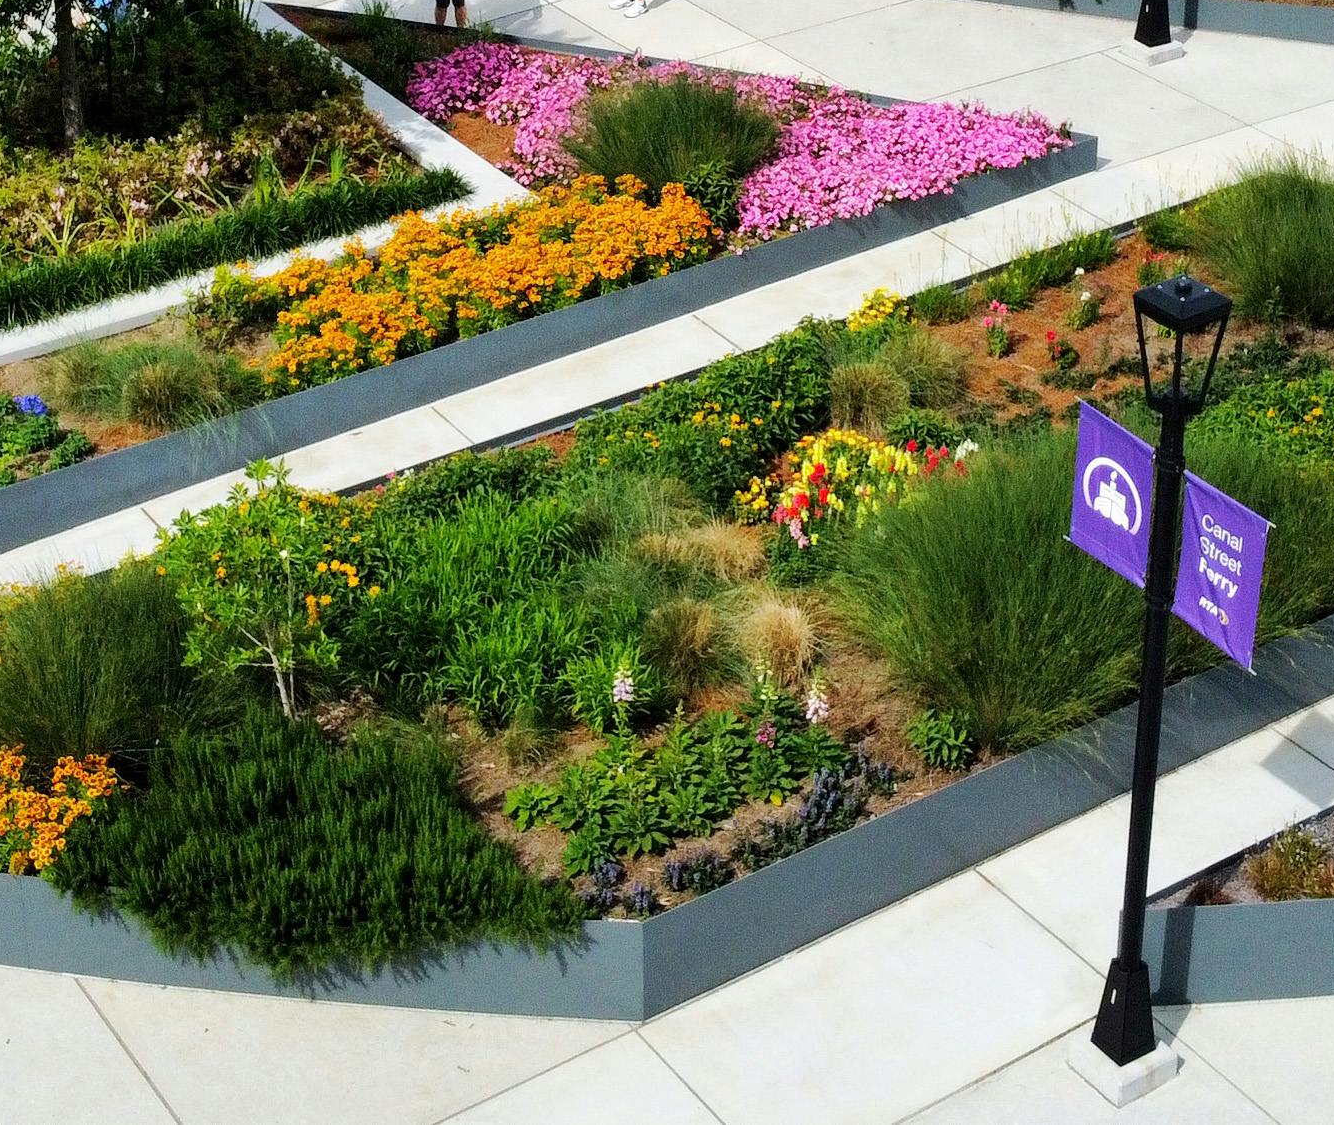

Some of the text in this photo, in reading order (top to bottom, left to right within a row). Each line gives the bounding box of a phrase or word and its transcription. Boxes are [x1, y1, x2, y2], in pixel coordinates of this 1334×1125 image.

[1201, 514, 1243, 553] Canal
[1199, 536, 1242, 577] Street
[1199, 557, 1238, 598] Ferry
[1199, 596, 1218, 617] RTA
